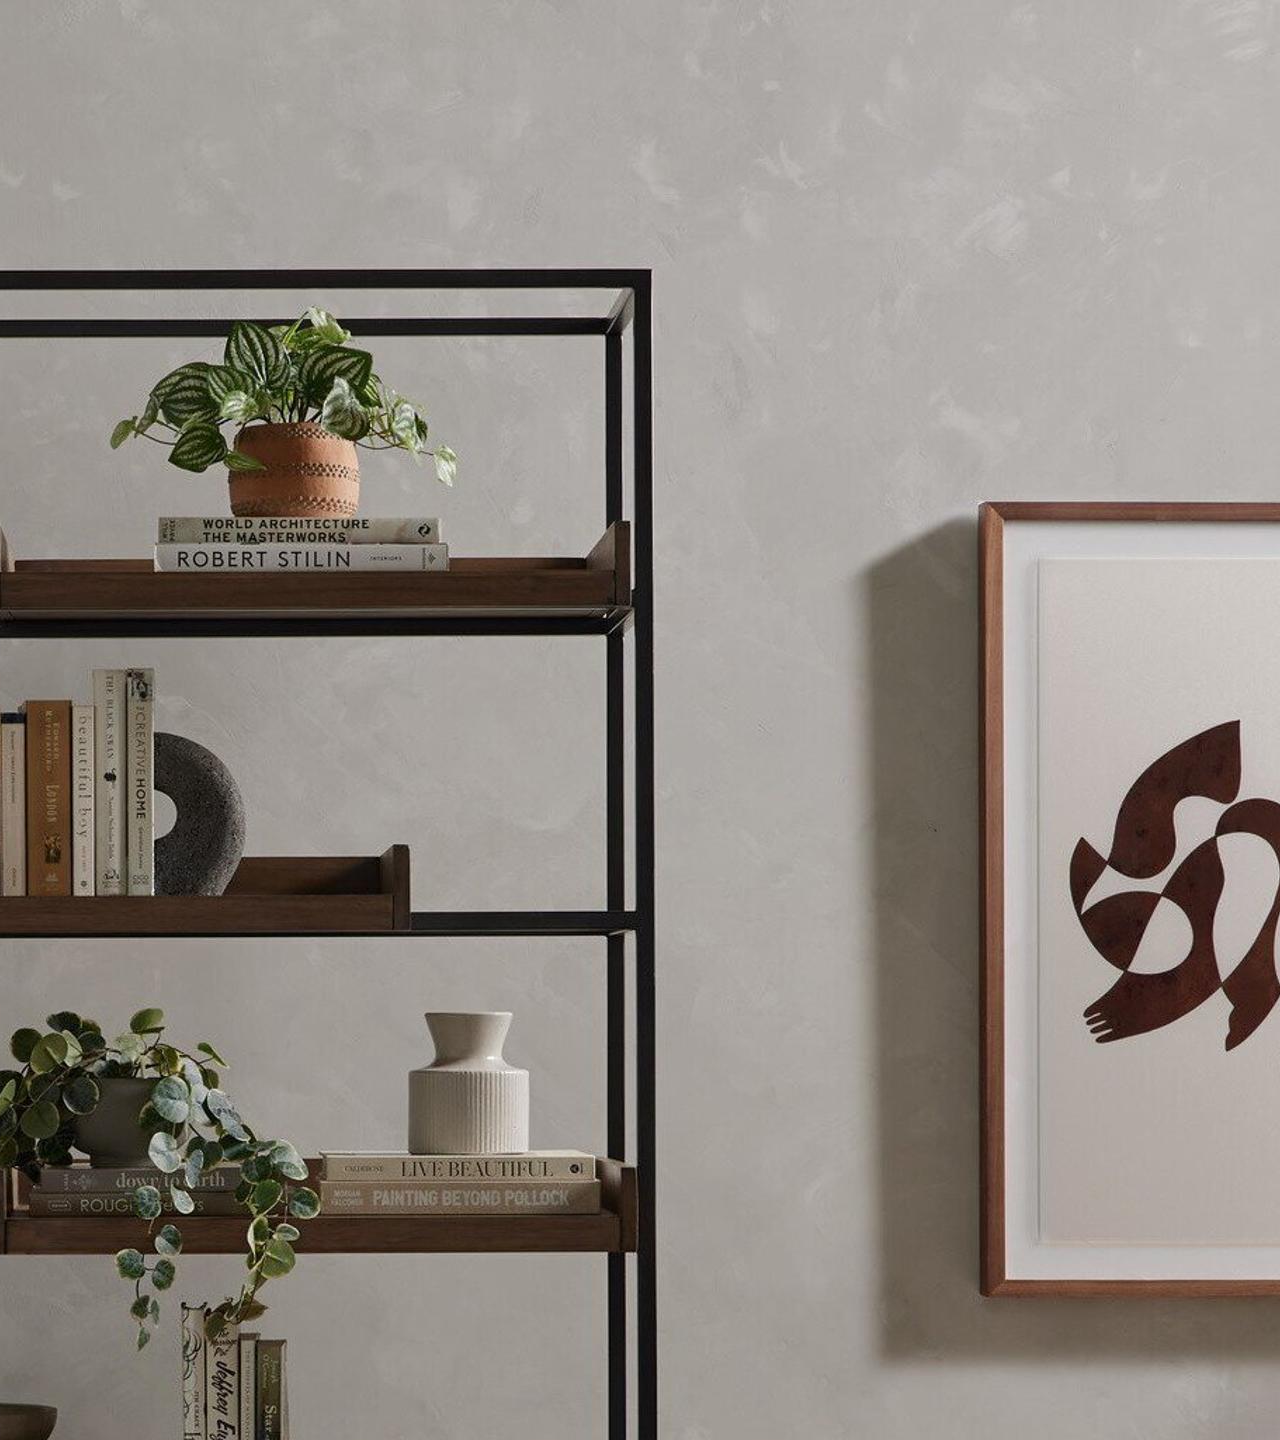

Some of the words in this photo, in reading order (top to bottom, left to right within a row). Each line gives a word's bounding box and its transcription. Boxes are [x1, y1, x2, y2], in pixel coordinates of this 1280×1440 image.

[202, 519, 254, 529] WORLD
[258, 519, 370, 529] ARCHITECTURE
[202, 532, 232, 543] THE
[236, 532, 346, 543] MASTERWORKS
[177, 551, 268, 568] ROBERT
[278, 551, 350, 568] STILIN
[106, 674, 114, 692] THE
[136, 711, 146, 774] CREATIVE
[78, 716, 92, 799] beautiful
[136, 778, 146, 819] HOME
[77, 808, 92, 838] boy
[401, 1161, 444, 1177] LIVE
[448, 1161, 554, 1177] BEAUTIFUL
[372, 1190, 438, 1206] PAINTING
[442, 1190, 500, 1206] BEYOND
[504, 1190, 570, 1206] POLLOCK
[210, 1360, 236, 1415] Jeffrey
[264, 1404, 277, 1432] Star
